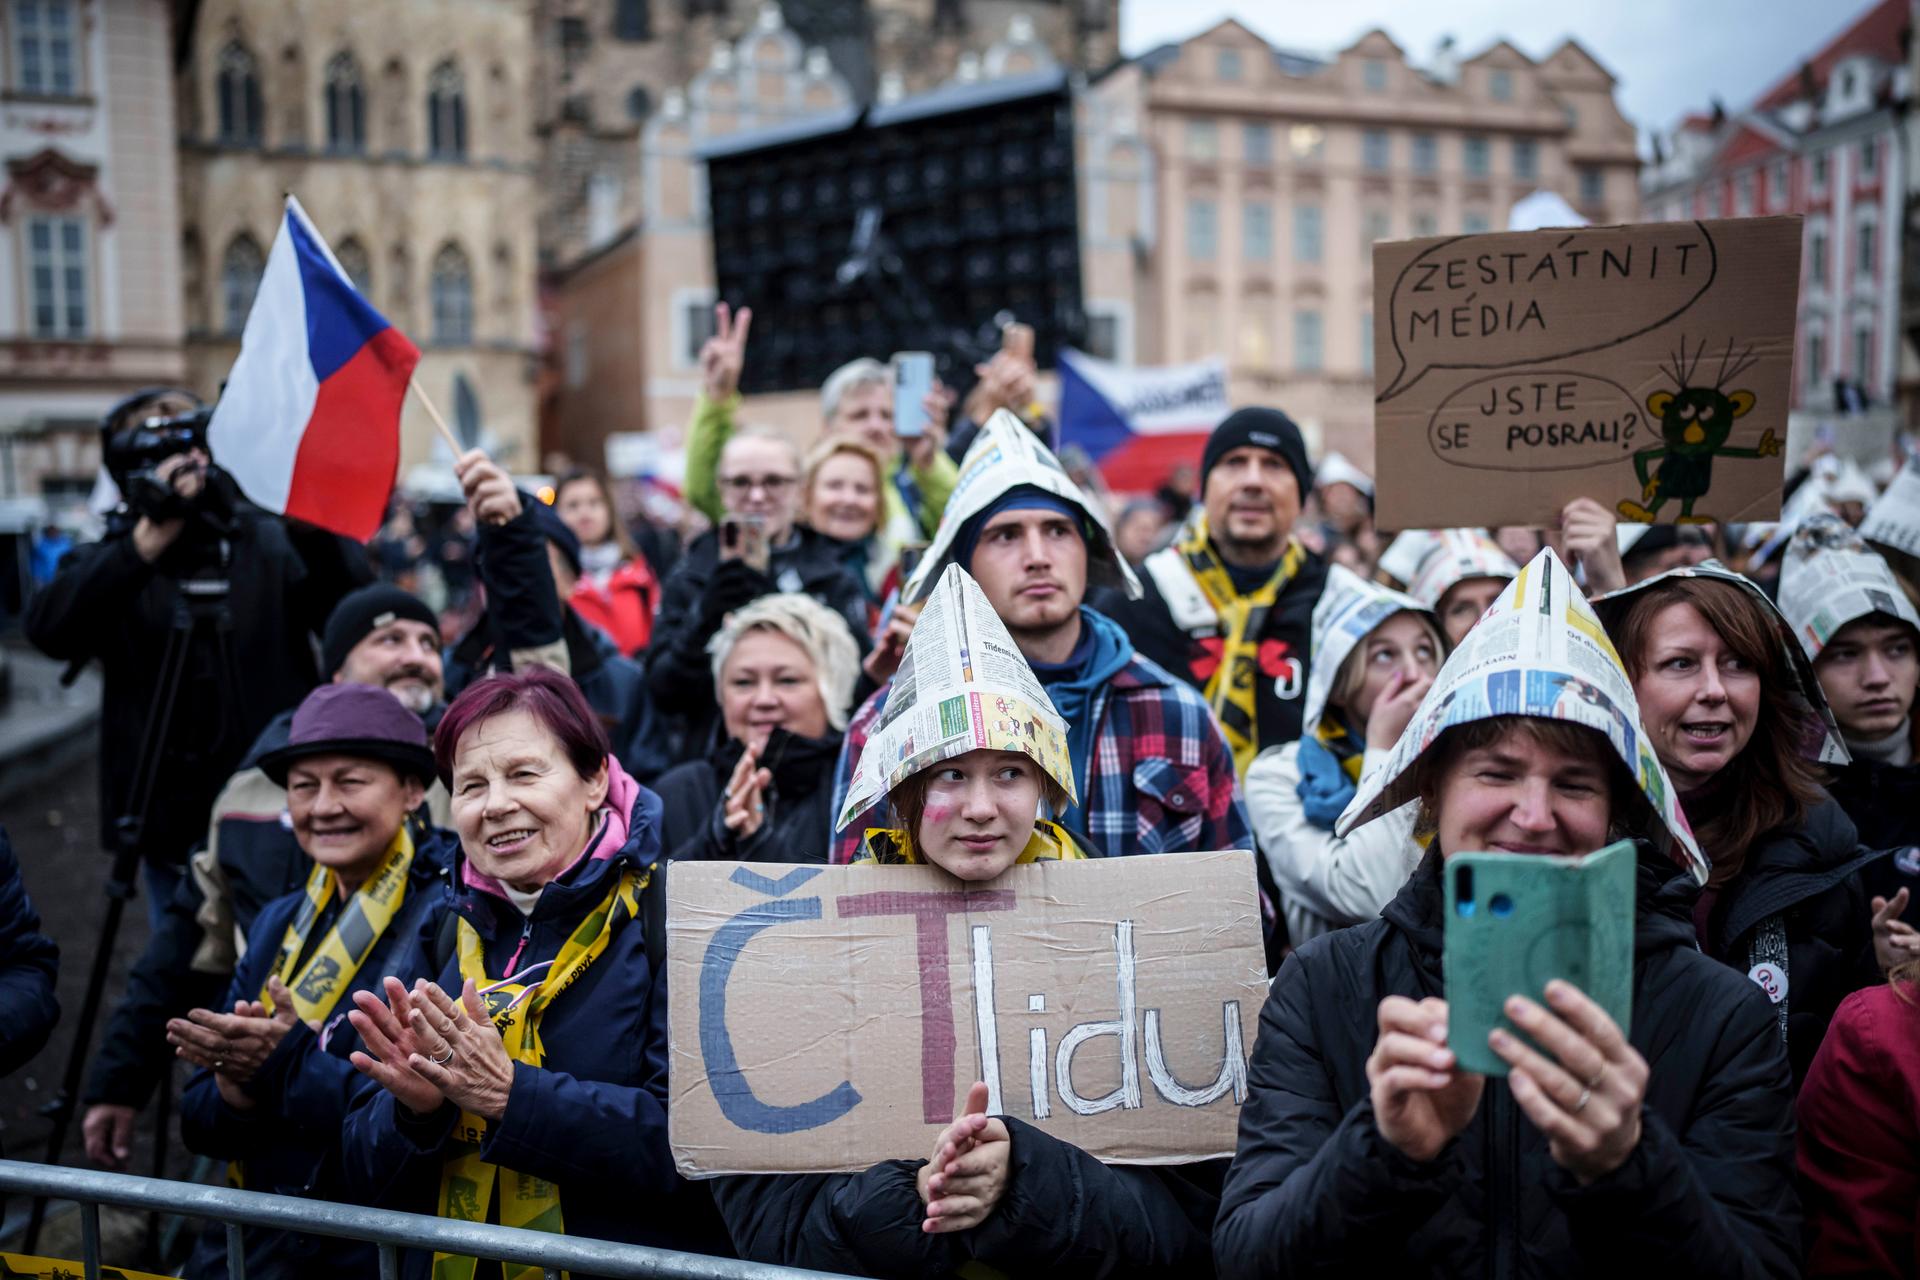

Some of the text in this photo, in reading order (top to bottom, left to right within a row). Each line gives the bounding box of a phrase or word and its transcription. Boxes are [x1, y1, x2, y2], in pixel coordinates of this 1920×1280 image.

[1412, 235, 1699, 292] ZESTÁTNIT
[1409, 292, 1546, 342] MÉDIA
[1480, 381, 1578, 416] JSTE
[1437, 413, 1638, 451] SE POSRALI?
